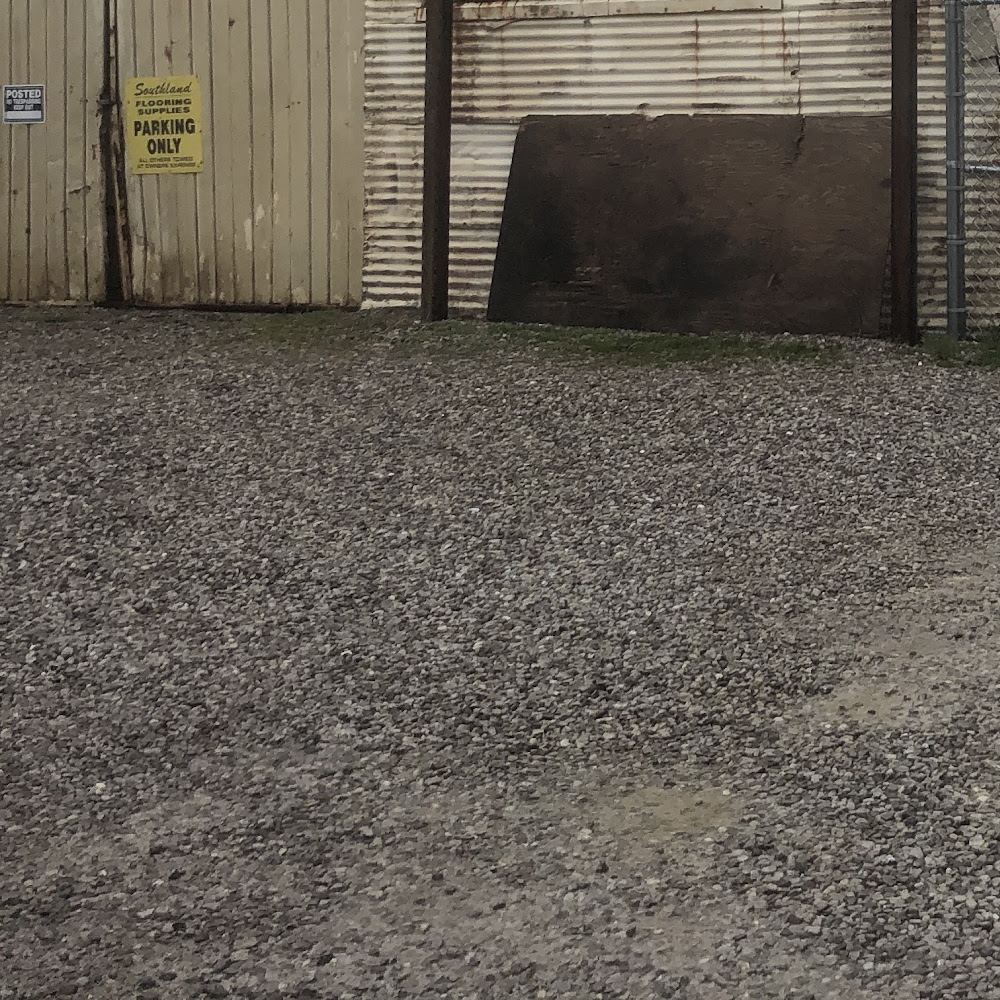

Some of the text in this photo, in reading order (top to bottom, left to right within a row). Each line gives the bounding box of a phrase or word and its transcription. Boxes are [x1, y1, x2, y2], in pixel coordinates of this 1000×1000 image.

[6, 89, 42, 99] POSTED
[134, 81, 192, 96] Southland
[135, 98, 192, 107] FLOORING
[137, 106, 191, 115] SUPPLIES
[134, 118, 195, 136] PARKING
[147, 138, 181, 155] ONLY
